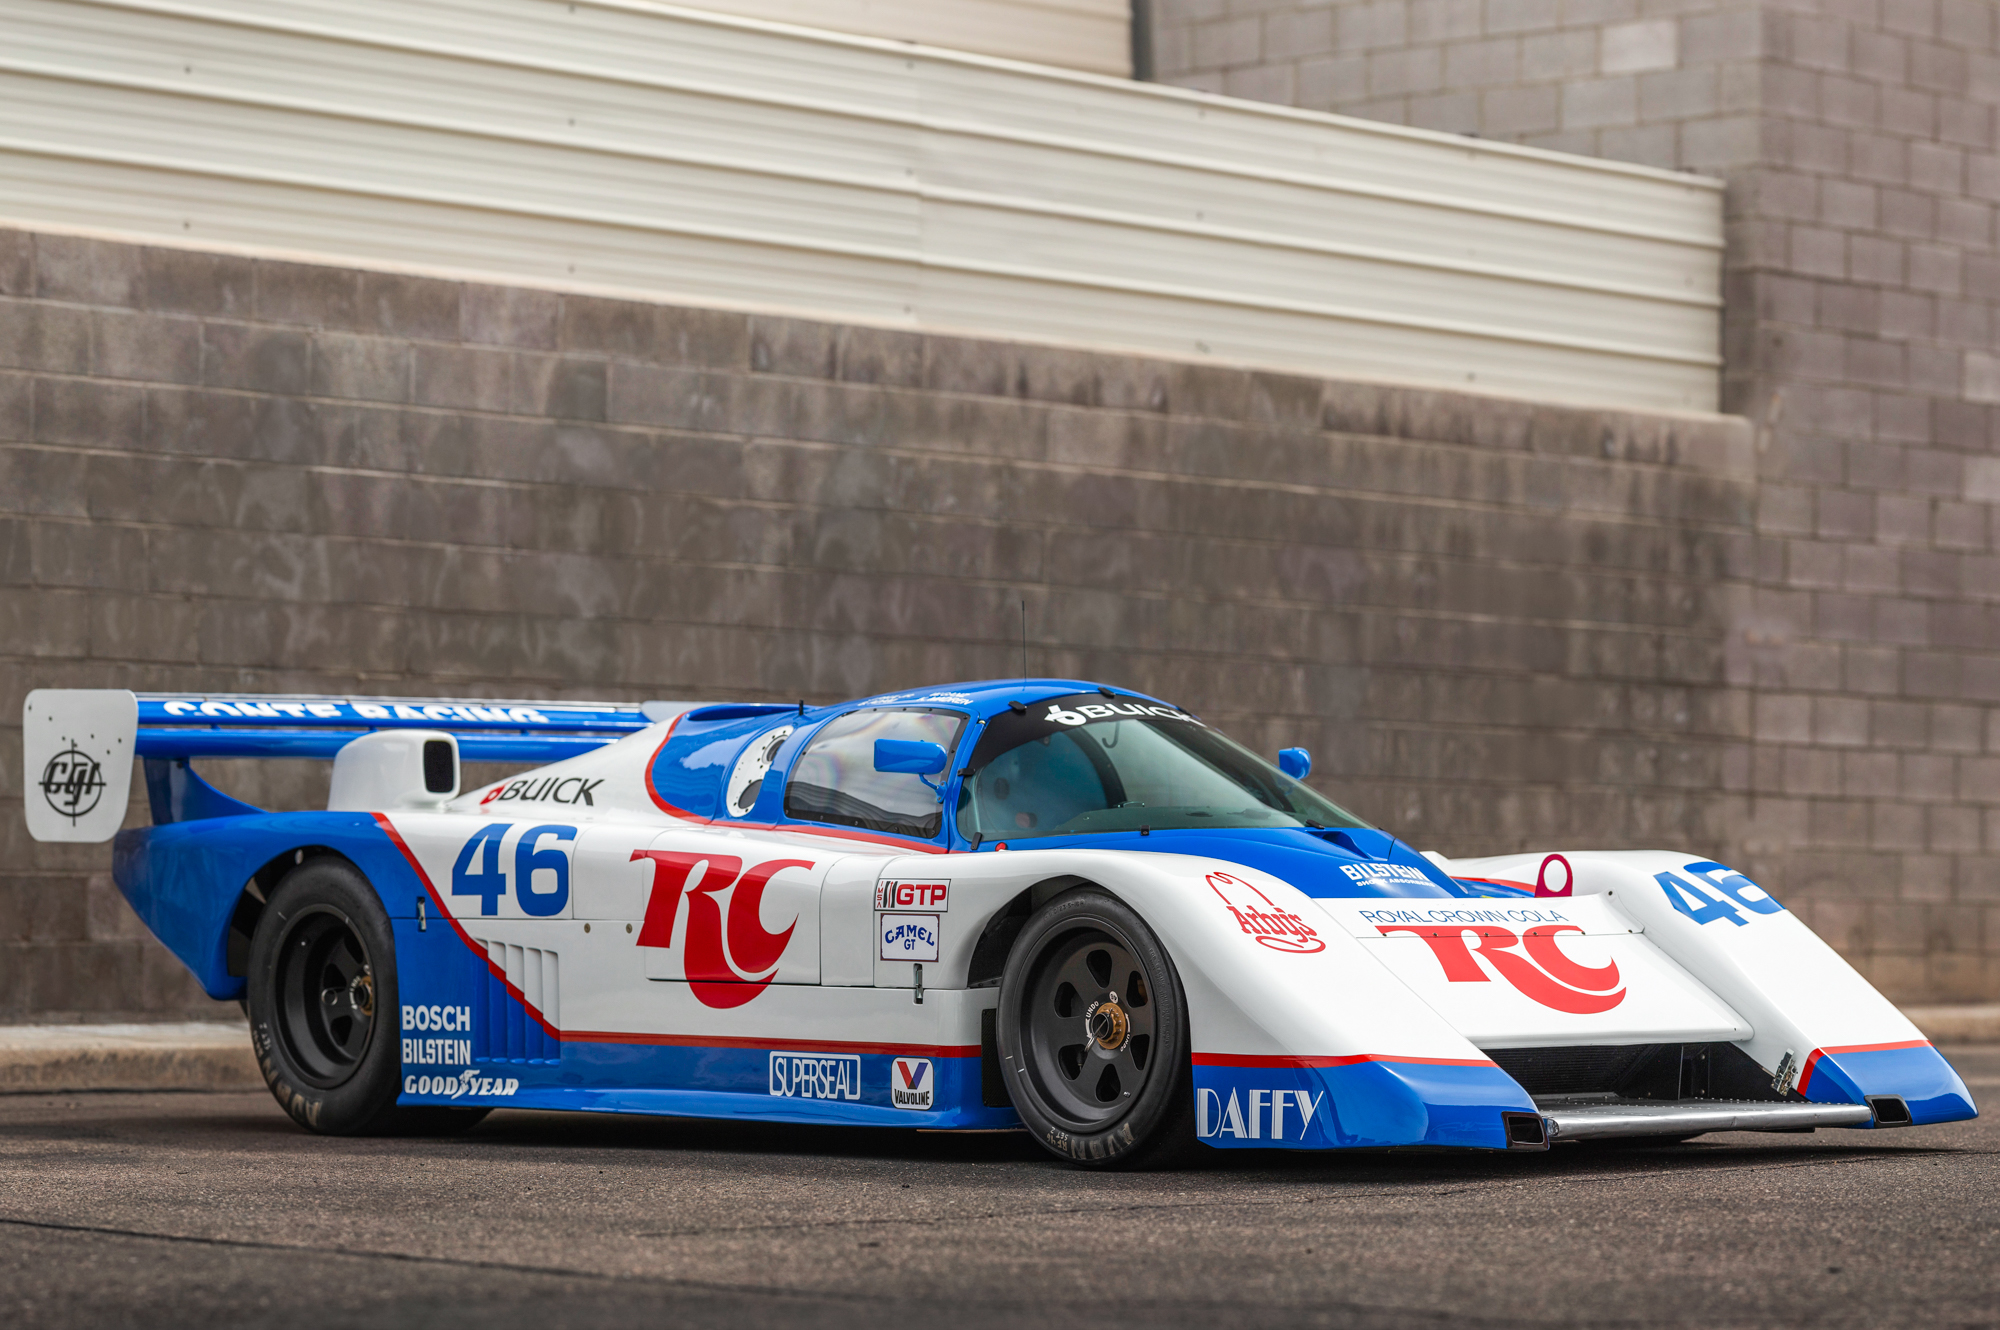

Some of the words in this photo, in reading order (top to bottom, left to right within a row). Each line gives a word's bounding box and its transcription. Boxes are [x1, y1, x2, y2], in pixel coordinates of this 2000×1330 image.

[1076, 703, 1207, 727] BUICK
[497, 777, 605, 806] BUICK
[451, 823, 578, 917] 46
[1339, 863, 1430, 881] BILSTEIN
[1356, 878, 1388, 887] SHOK
[1653, 861, 1786, 927] 46
[896, 884, 947, 906] GTP
[1358, 910, 1433, 923] ROYAL
[1428, 910, 1510, 923] CROWN
[1507, 910, 1570, 923] COLA
[629, 849, 816, 1009] RC
[885, 924, 935, 947] CAMEL
[904, 938, 916, 950] GT
[1374, 924, 1627, 1014] RC
[402, 1005, 471, 1032] BOSCH
[1085, 1000, 1100, 1018] UNDO
[402, 1038, 471, 1065] BILSTEIN
[404, 1073, 519, 1097] GOODYEAR
[774, 1057, 860, 1100] SUPERSEAL
[894, 1089, 930, 1106] VALVOLINE
[1196, 1087, 1324, 1140] DAFFY
